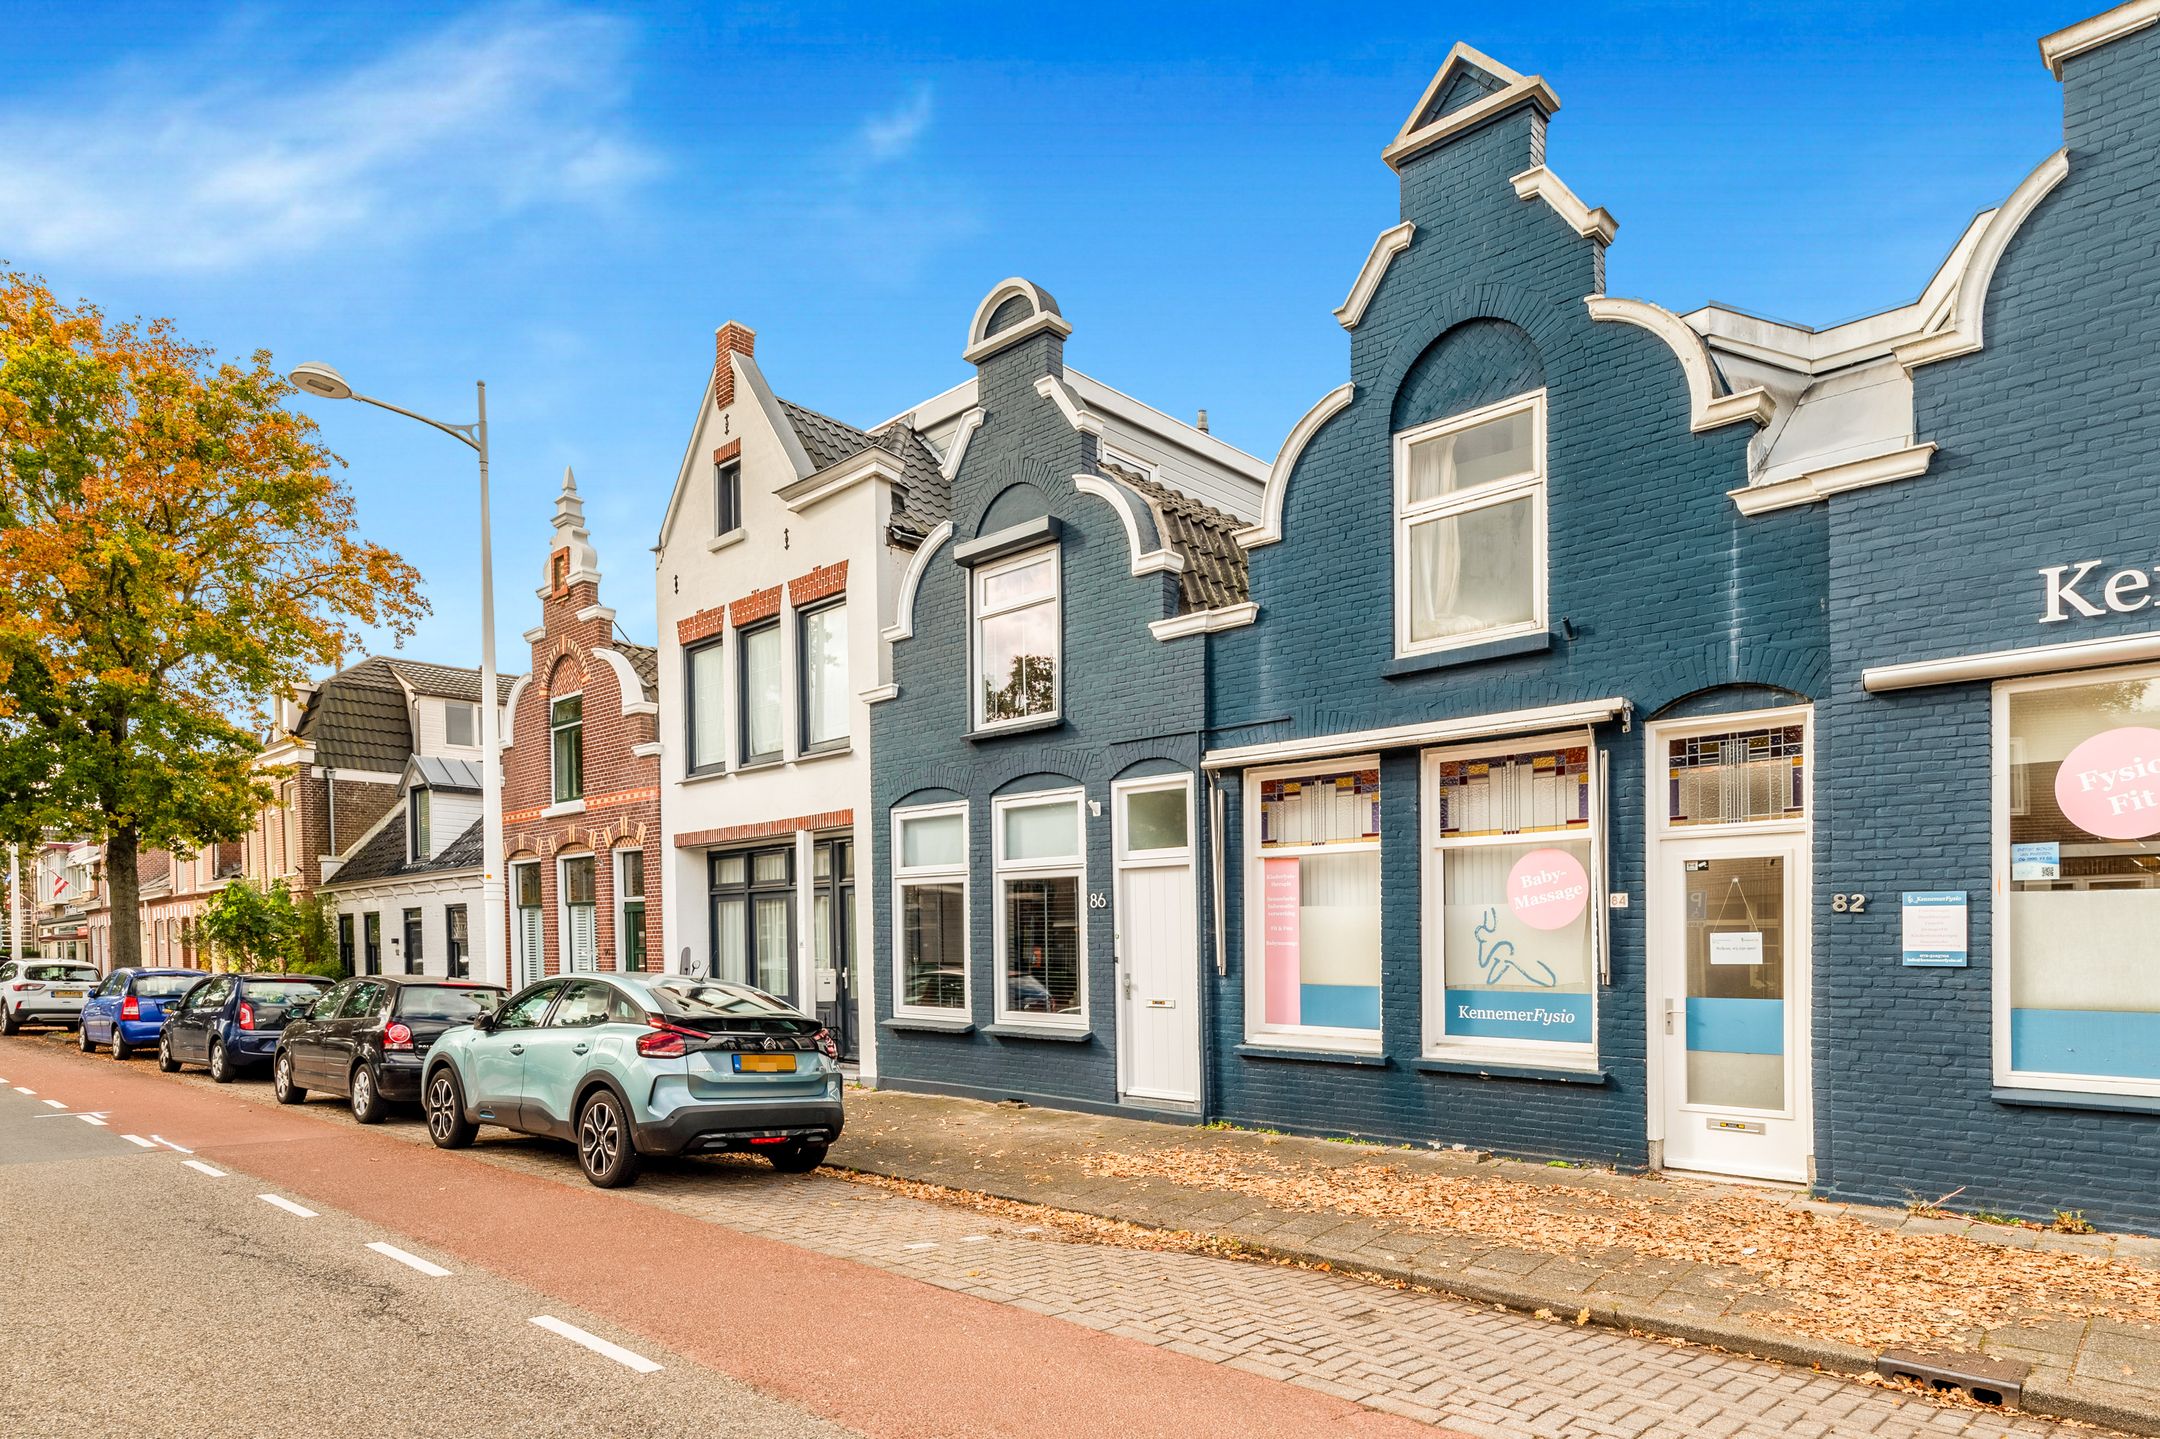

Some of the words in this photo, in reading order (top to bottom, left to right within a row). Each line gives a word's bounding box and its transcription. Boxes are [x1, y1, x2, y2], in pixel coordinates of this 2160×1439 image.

[2038, 560, 2160, 623] Ke
[2107, 789, 2159, 816] Fit
[1520, 869, 1568, 889] Baby-
[1090, 892, 1106, 908] 86
[1513, 884, 1584, 910] Massage
[1611, 895, 1627, 906] 84
[1832, 893, 1866, 912] 82
[1458, 1005, 1576, 1026] KennemerFysio
